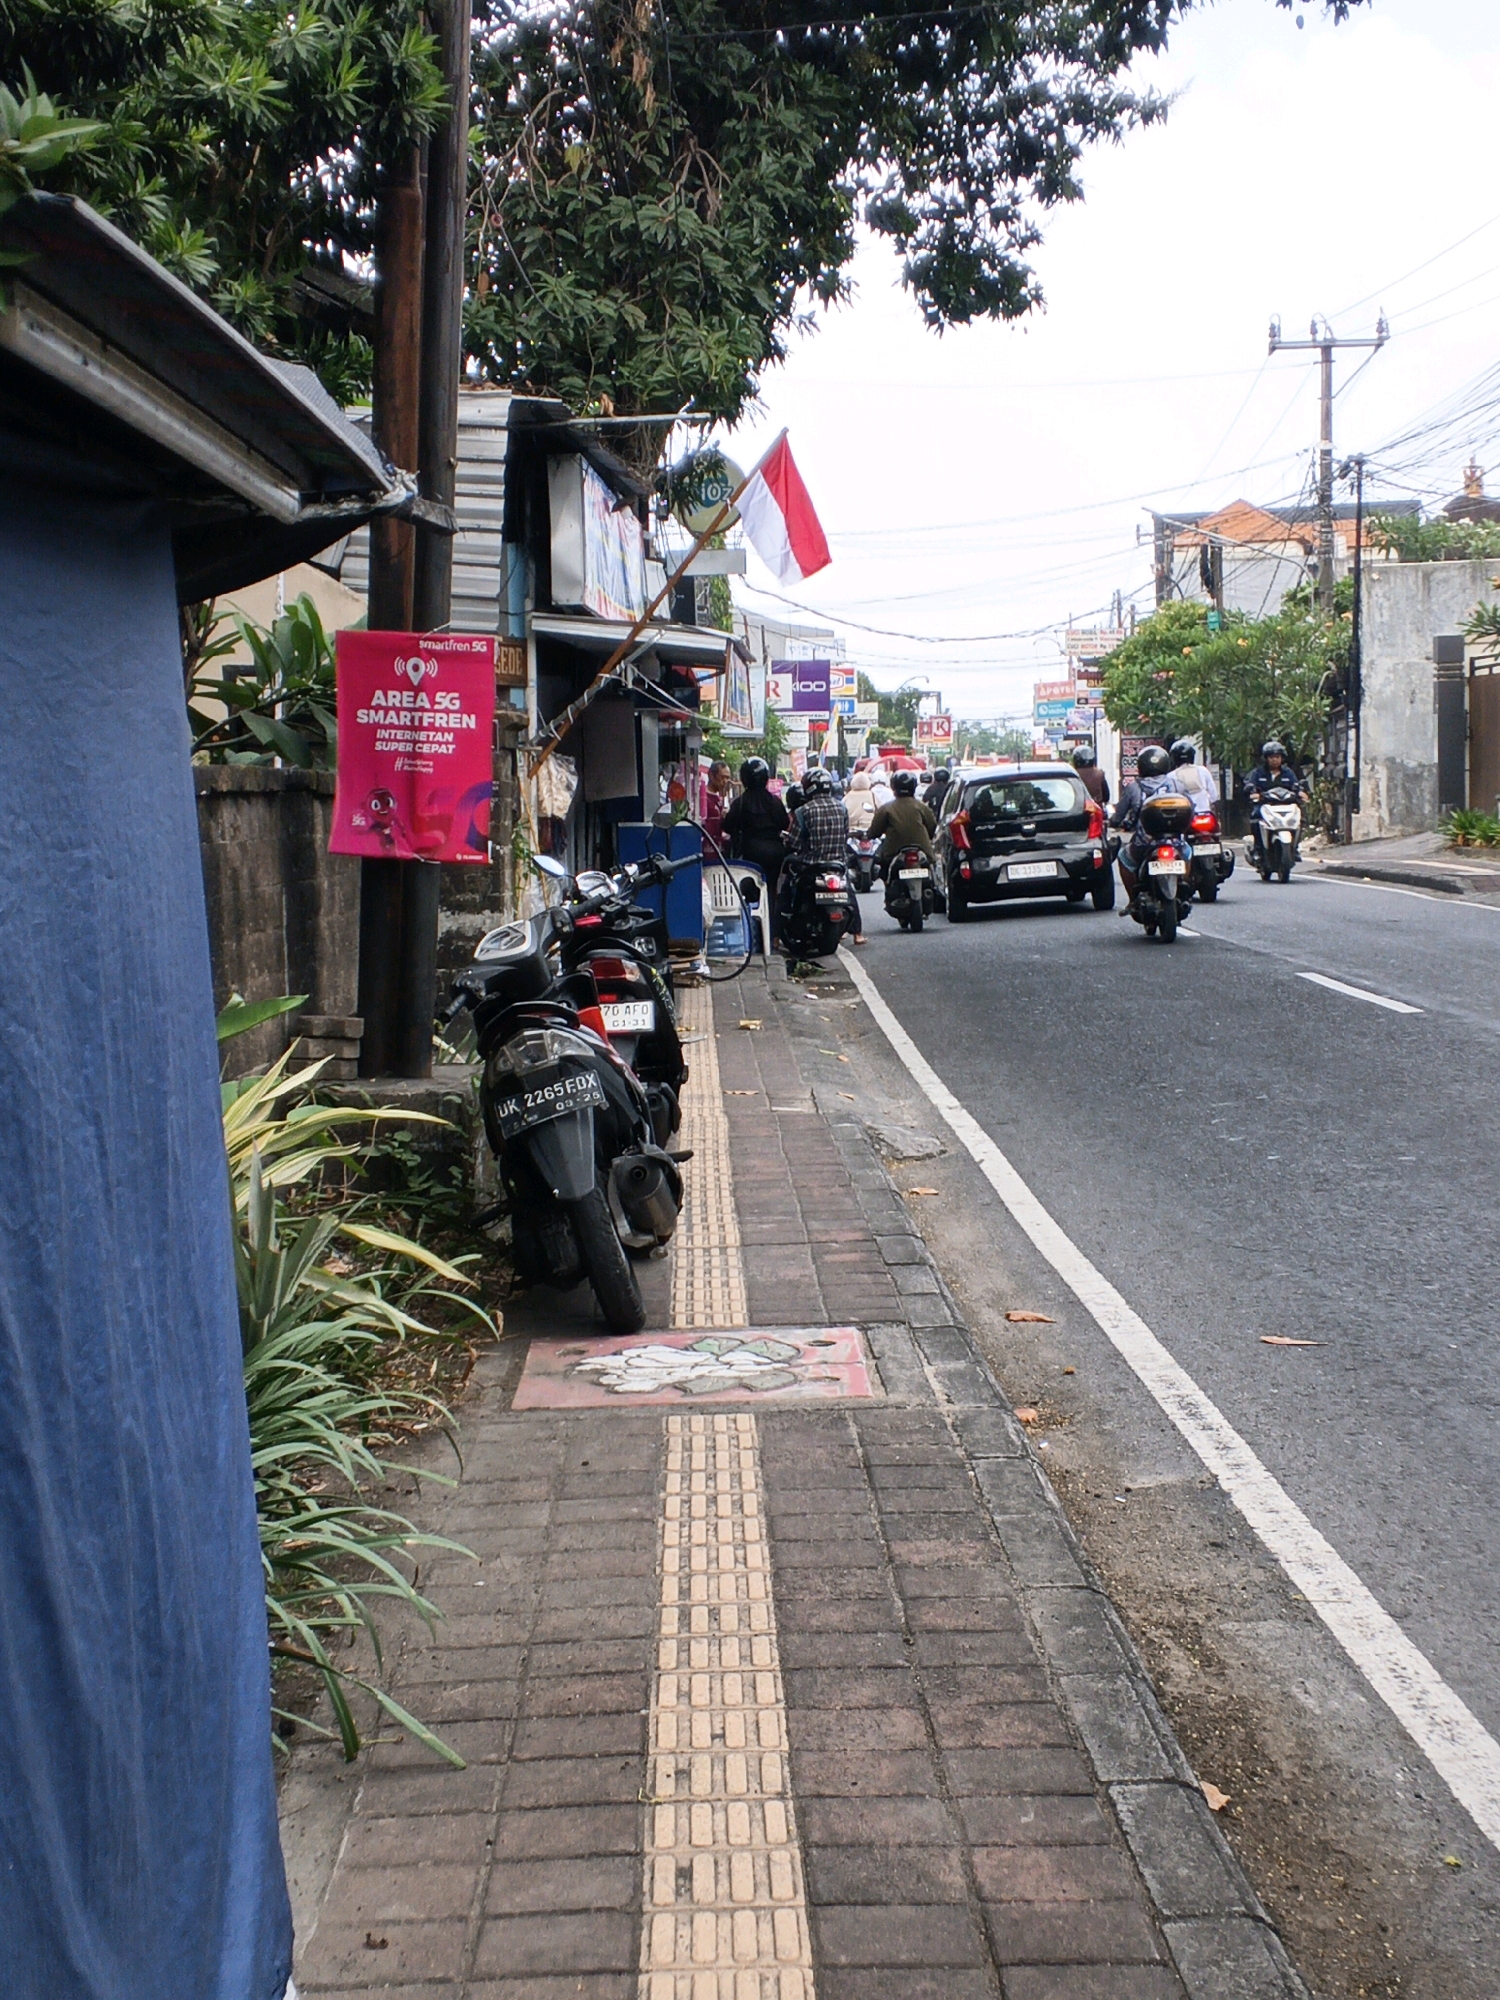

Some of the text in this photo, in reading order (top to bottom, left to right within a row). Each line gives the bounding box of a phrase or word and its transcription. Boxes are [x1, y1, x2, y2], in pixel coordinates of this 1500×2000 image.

[419, 640, 487, 652] smartfren 5G
[371, 690, 460, 710] AREA 5G
[356, 709, 476, 729] SMARTFREN
[376, 729, 454, 742] INTERNETAN
[375, 741, 455, 754] SUPER CEPAT
[524, 1082, 564, 1107] 2265
